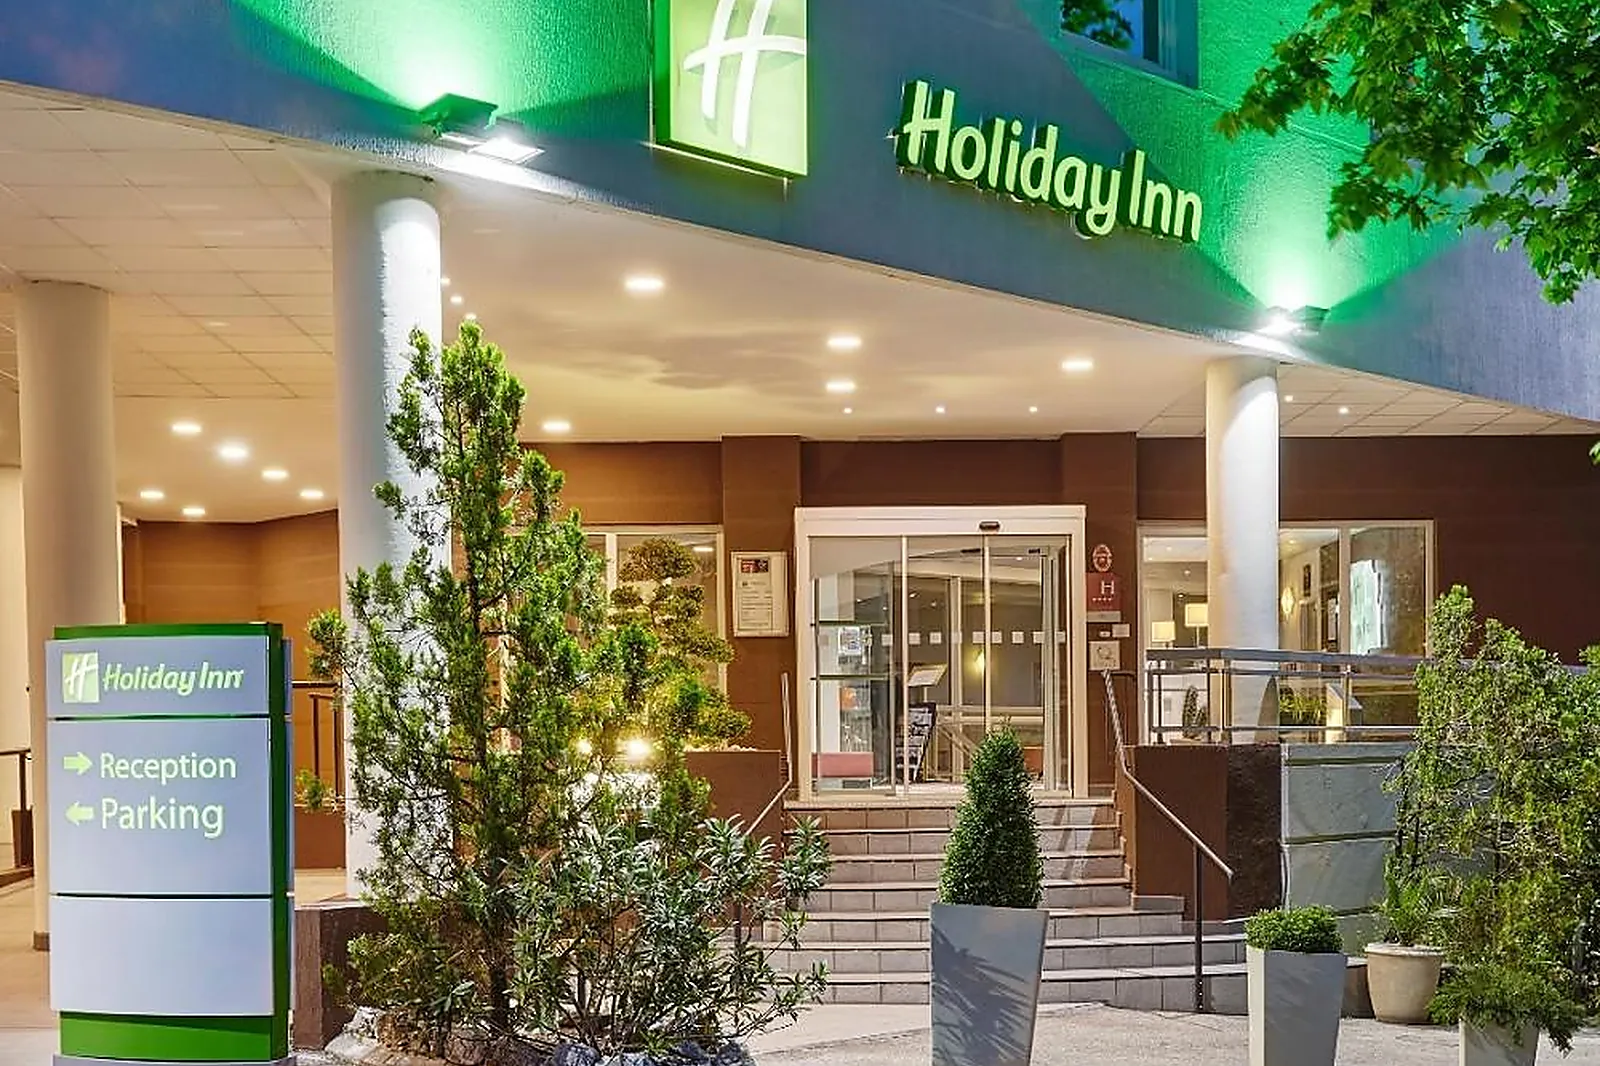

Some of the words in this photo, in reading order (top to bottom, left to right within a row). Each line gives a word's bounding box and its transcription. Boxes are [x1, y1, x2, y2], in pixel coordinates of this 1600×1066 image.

[902, 80, 1121, 236] Holiday
[1129, 148, 1203, 242] Inn
[1100, 579, 1115, 595] H
[102, 663, 196, 696] Holiday
[199, 661, 244, 689] Inn
[99, 751, 237, 786] Reception
[100, 796, 224, 839] Parking
